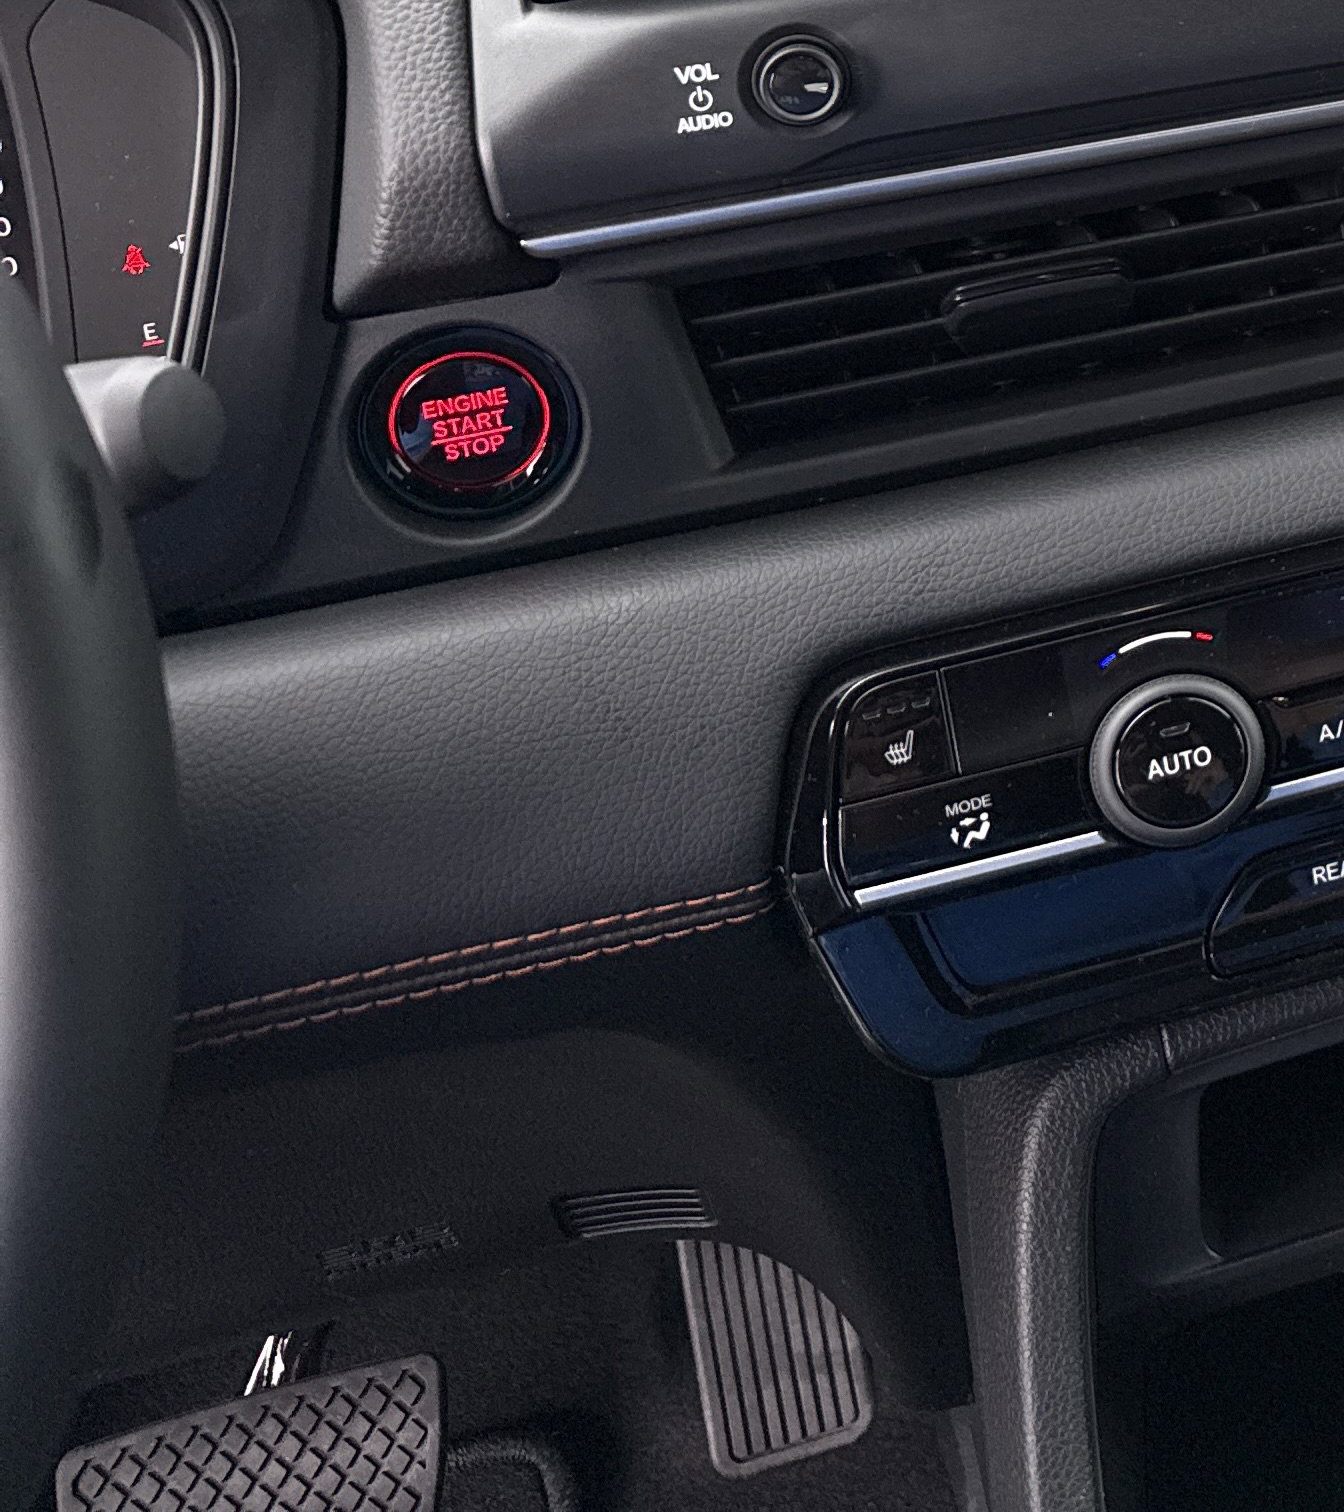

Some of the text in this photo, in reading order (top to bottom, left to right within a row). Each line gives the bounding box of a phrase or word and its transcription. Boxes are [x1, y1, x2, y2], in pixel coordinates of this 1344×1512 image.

[673, 62, 720, 85] VOL
[676, 111, 734, 135] AUDIO
[142, 322, 159, 341] E
[420, 386, 510, 421] ENGINE
[431, 408, 505, 439] START
[444, 434, 505, 463] STOP
[1147, 745, 1212, 781] AUTO
[944, 793, 993, 818] MODE
